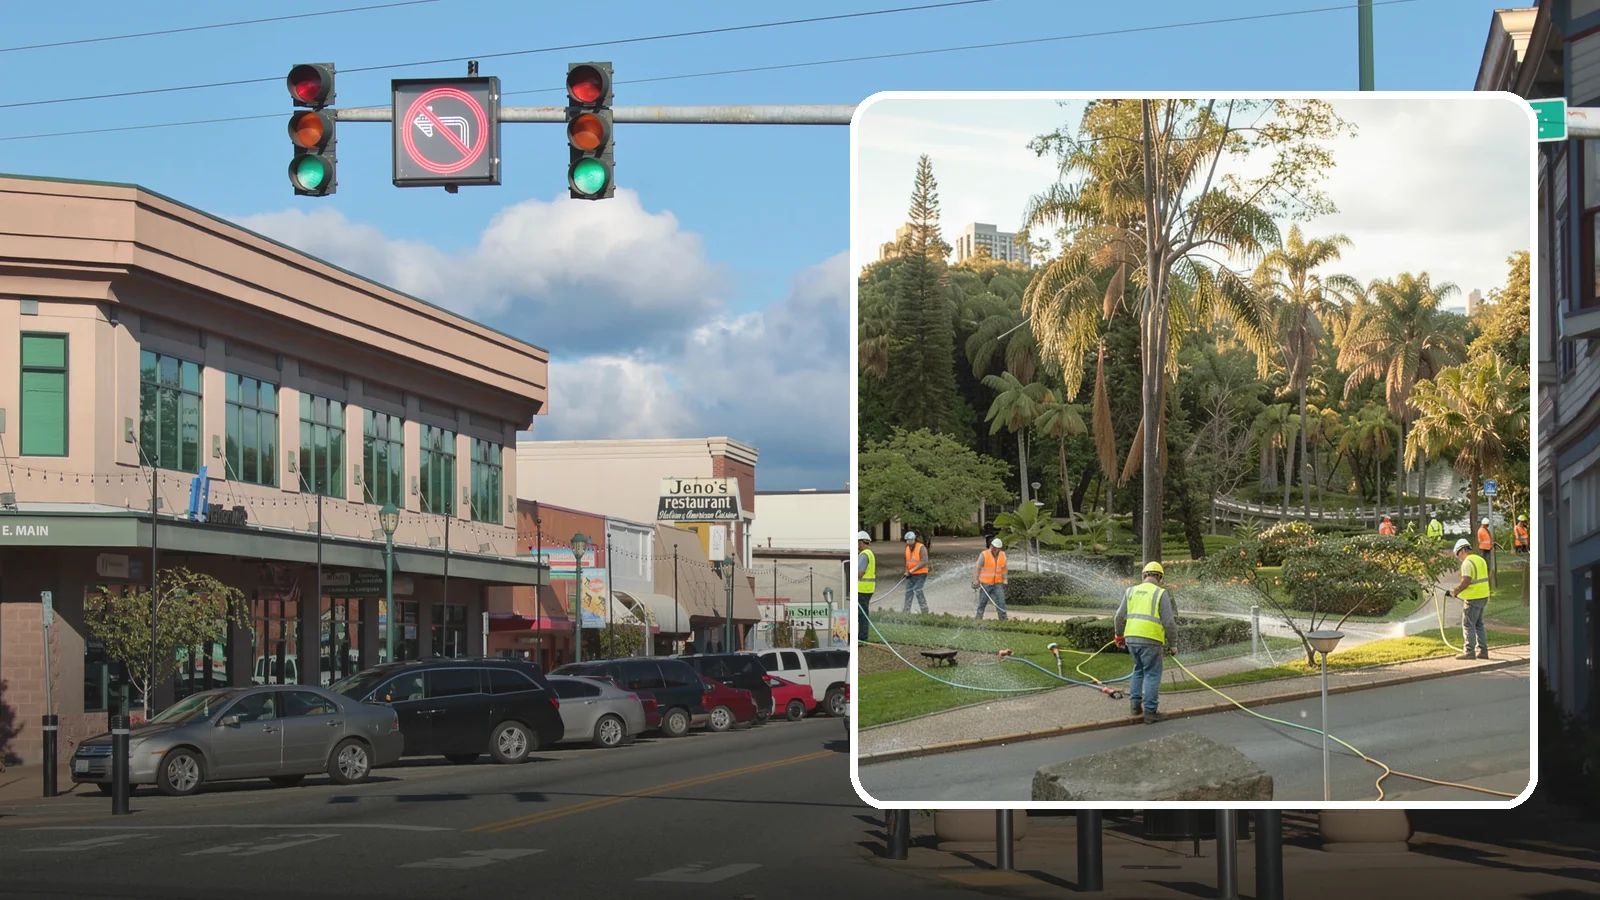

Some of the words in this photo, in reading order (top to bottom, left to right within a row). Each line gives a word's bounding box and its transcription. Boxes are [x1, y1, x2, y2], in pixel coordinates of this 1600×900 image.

[669, 480, 728, 495] Jeno's
[665, 496, 731, 509] restaurant
[658, 509, 681, 519] Italian
[686, 509, 715, 519] American
[715, 509, 738, 519] Cuisine
[2, 525, 13, 536] E.
[15, 525, 49, 536] MAIN
[797, 607, 828, 617] Street
